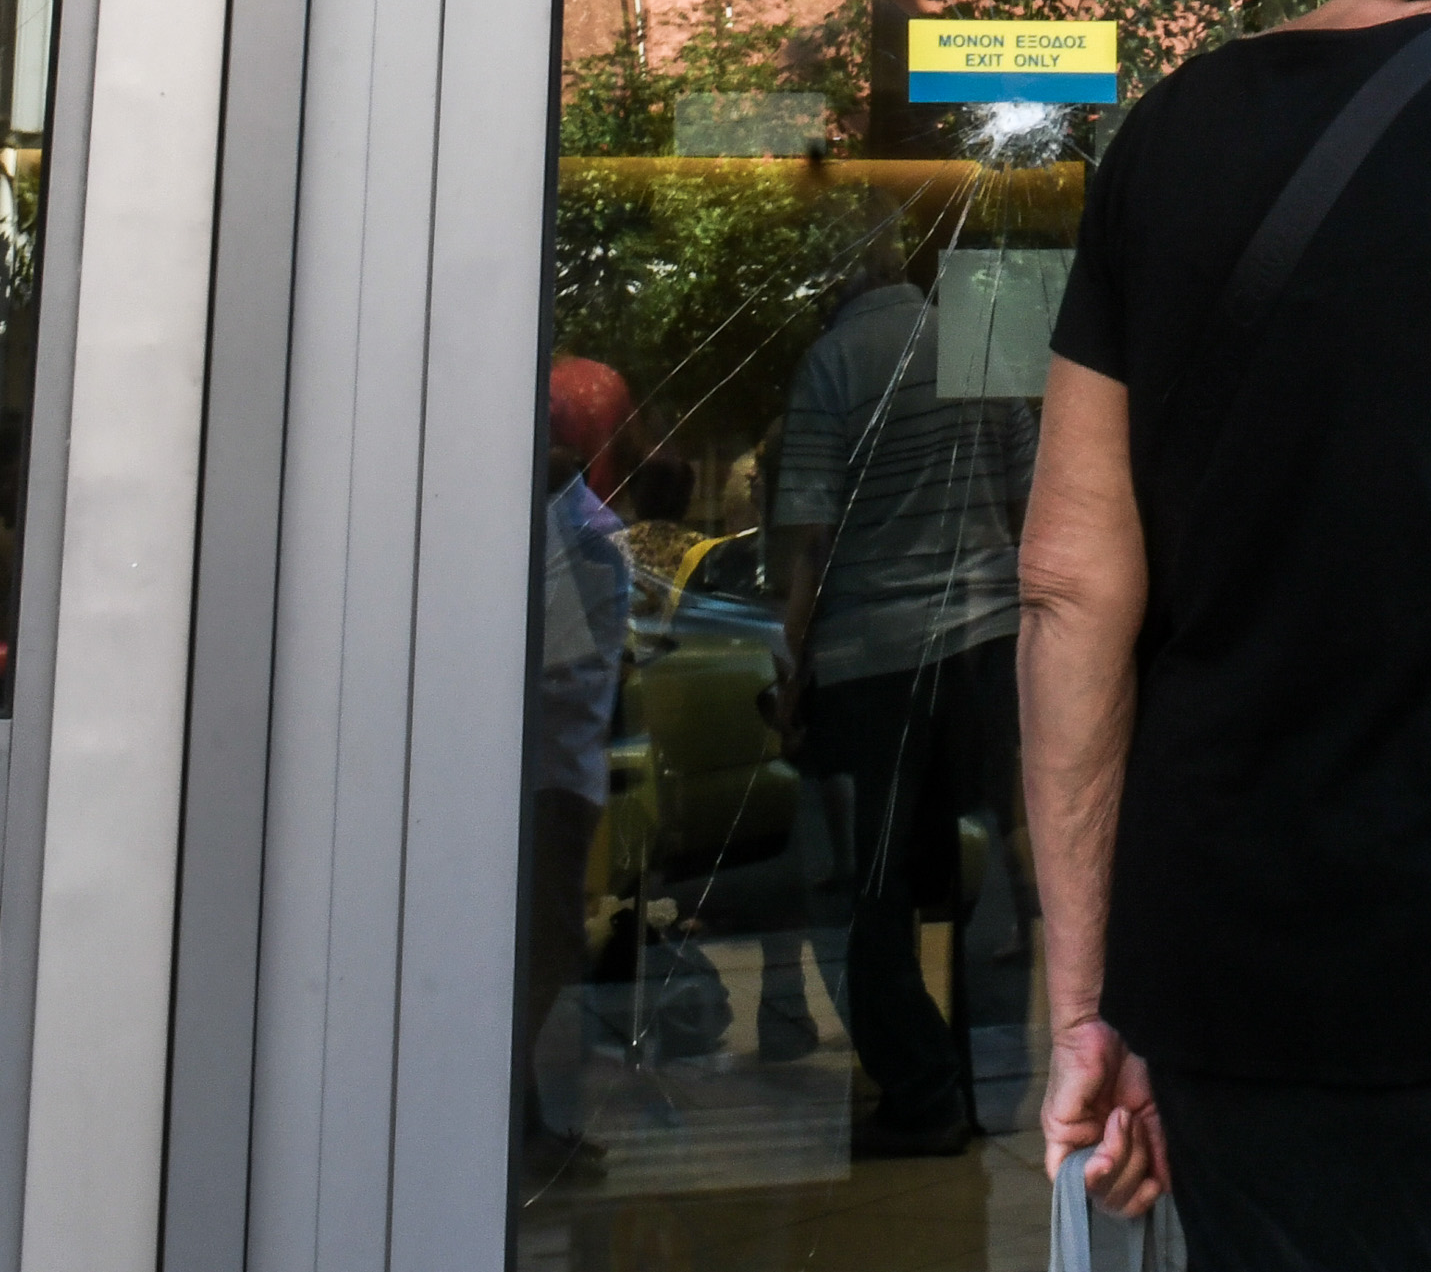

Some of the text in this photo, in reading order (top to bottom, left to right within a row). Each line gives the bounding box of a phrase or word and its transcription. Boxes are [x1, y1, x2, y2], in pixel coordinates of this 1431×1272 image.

[938, 34, 1087, 49] ΜΟΝΟΝ ΕΞΟΔΟΣ
[965, 53, 1060, 68] EXIT ONLY
